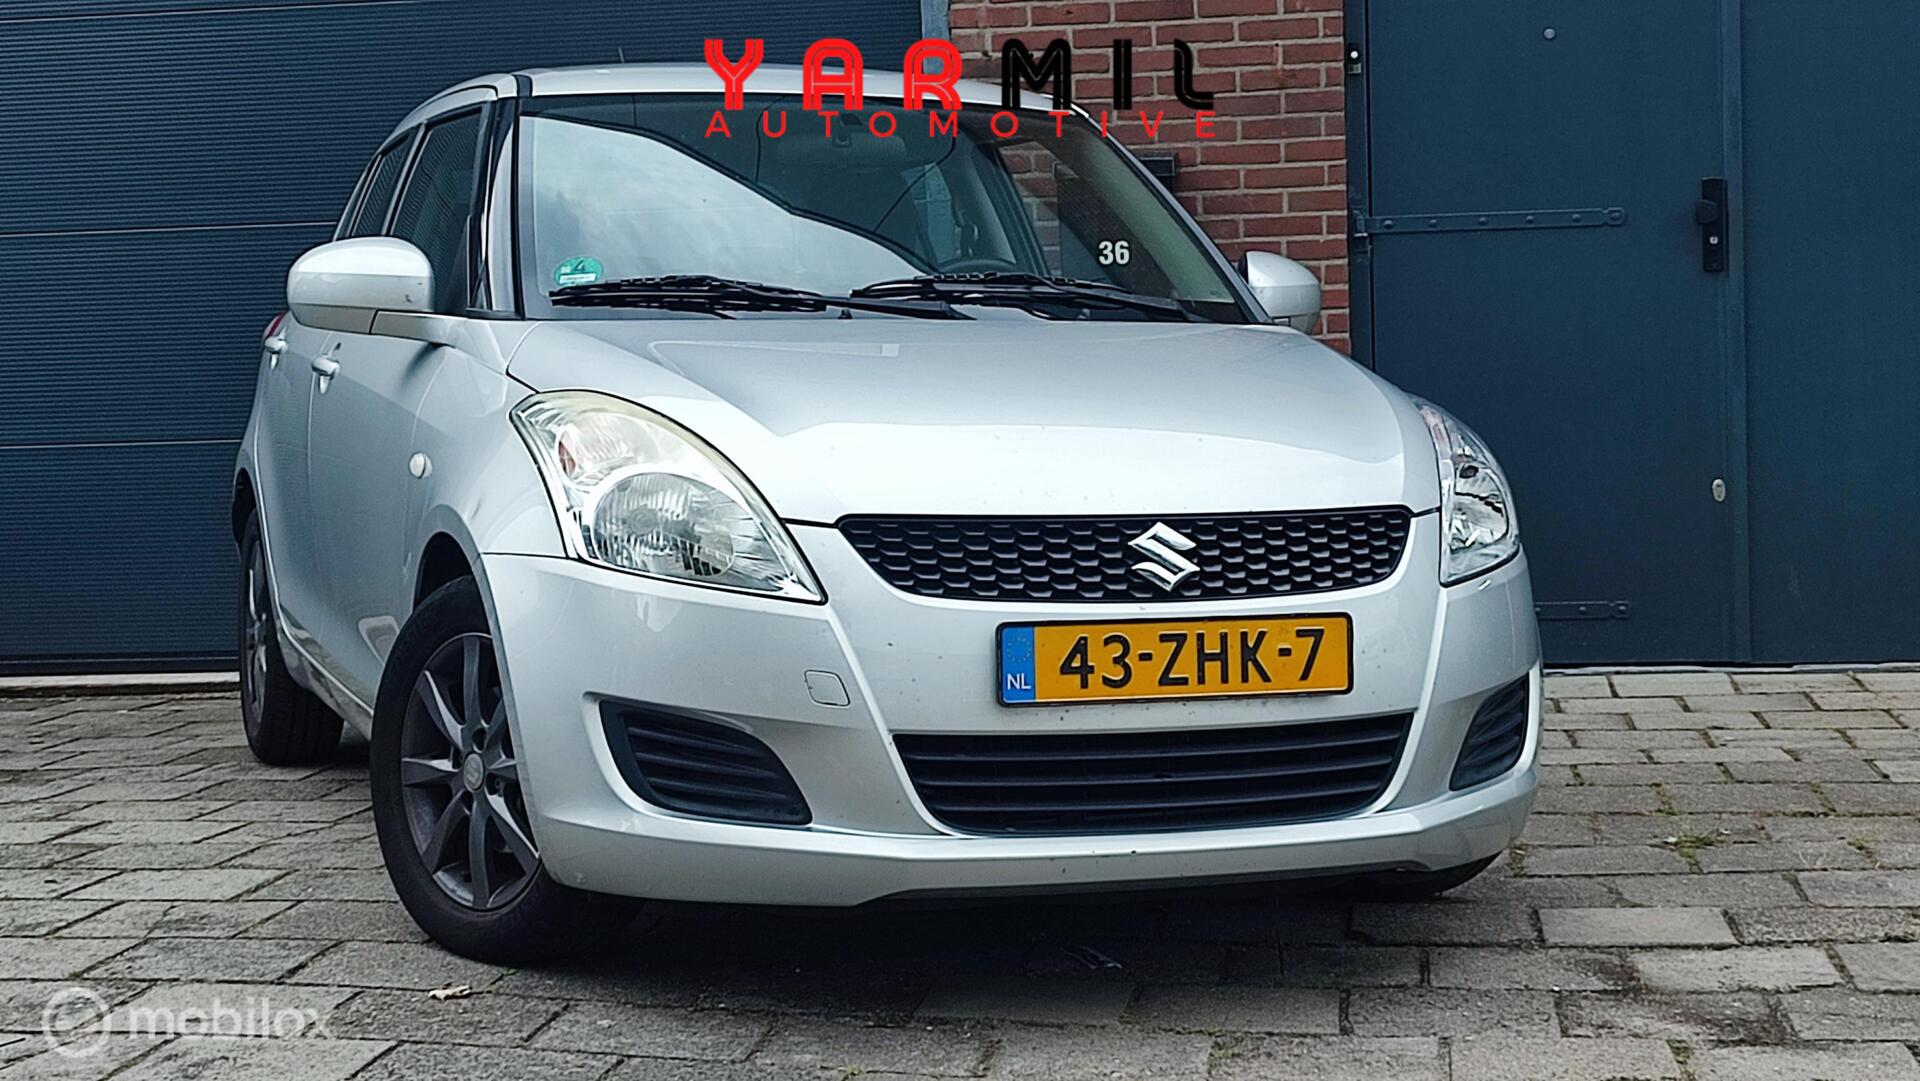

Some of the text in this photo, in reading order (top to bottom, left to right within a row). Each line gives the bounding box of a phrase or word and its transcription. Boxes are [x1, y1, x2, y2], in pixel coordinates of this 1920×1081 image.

[1098, 240, 1130, 265] 36
[573, 259, 586, 272] 4
[1058, 628, 1326, 690] 43-ZHK-7
[1007, 672, 1032, 690] NL
